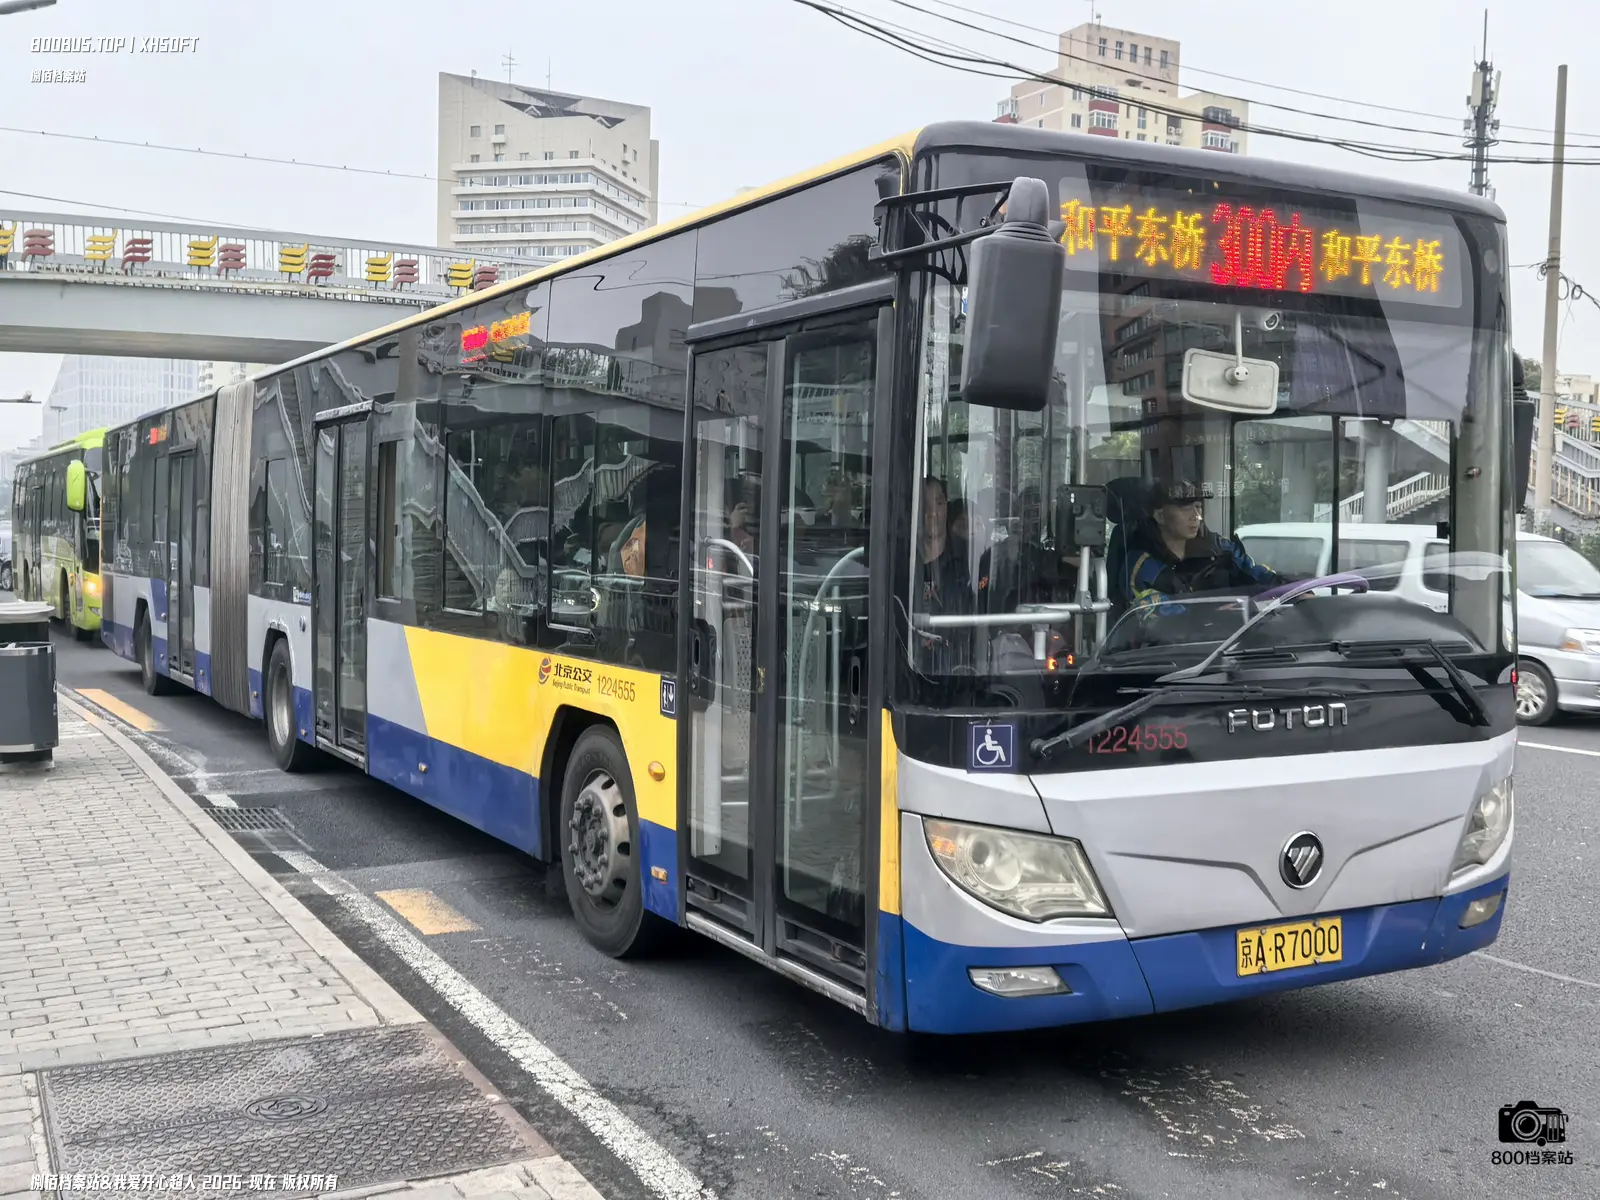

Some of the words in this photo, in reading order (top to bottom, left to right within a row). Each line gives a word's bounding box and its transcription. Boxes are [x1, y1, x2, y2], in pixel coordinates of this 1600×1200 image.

[1060, 199, 1205, 270] 和平东桥
[1210, 203, 1313, 292] 300内
[1319, 229, 1443, 293] 和平东桥
[553, 663, 593, 683] 北京公交
[597, 674, 636, 702] 1224555
[1226, 702, 1349, 734] FOTON
[1088, 724, 1188, 755] 1224555
